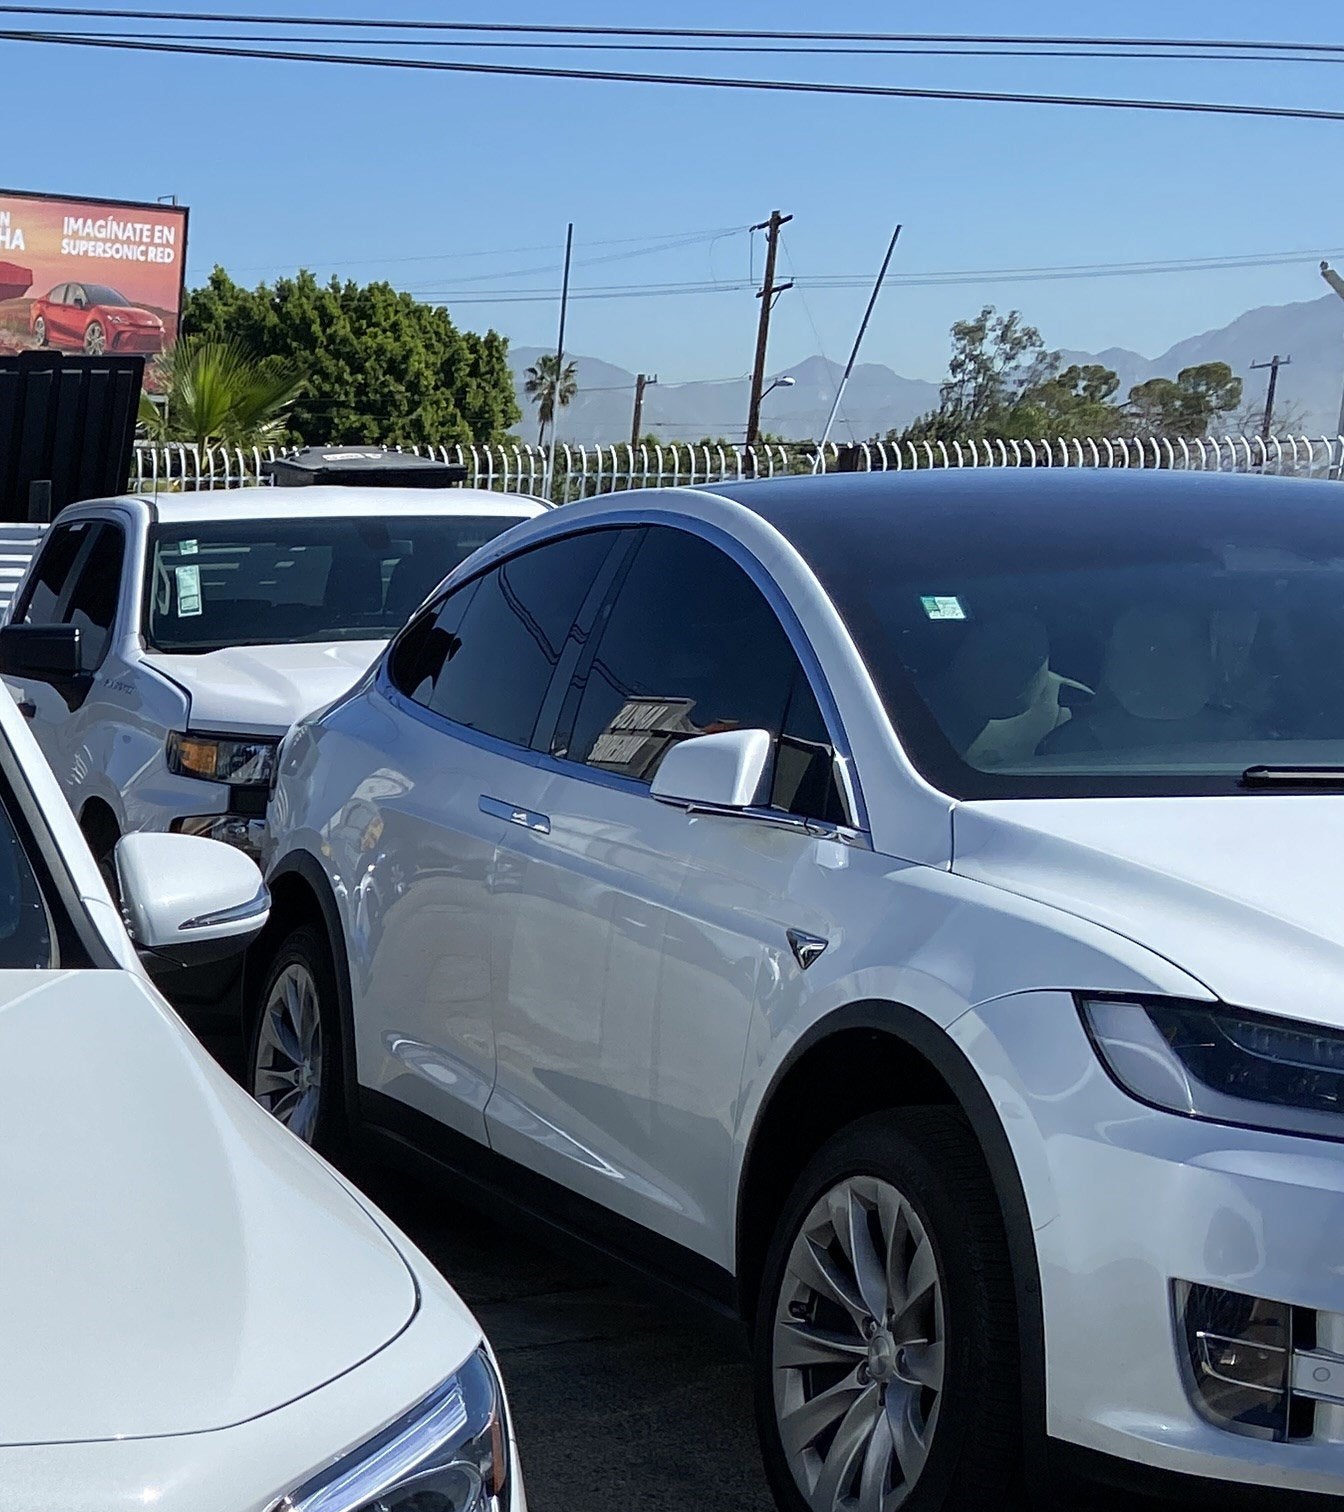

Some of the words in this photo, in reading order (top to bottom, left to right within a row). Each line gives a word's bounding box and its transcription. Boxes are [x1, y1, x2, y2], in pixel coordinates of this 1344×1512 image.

[63, 215, 152, 242] IMAGÍNATE
[154, 225, 175, 245] EN
[61, 238, 146, 262] SUPERSONIC
[147, 246, 174, 264] RED
